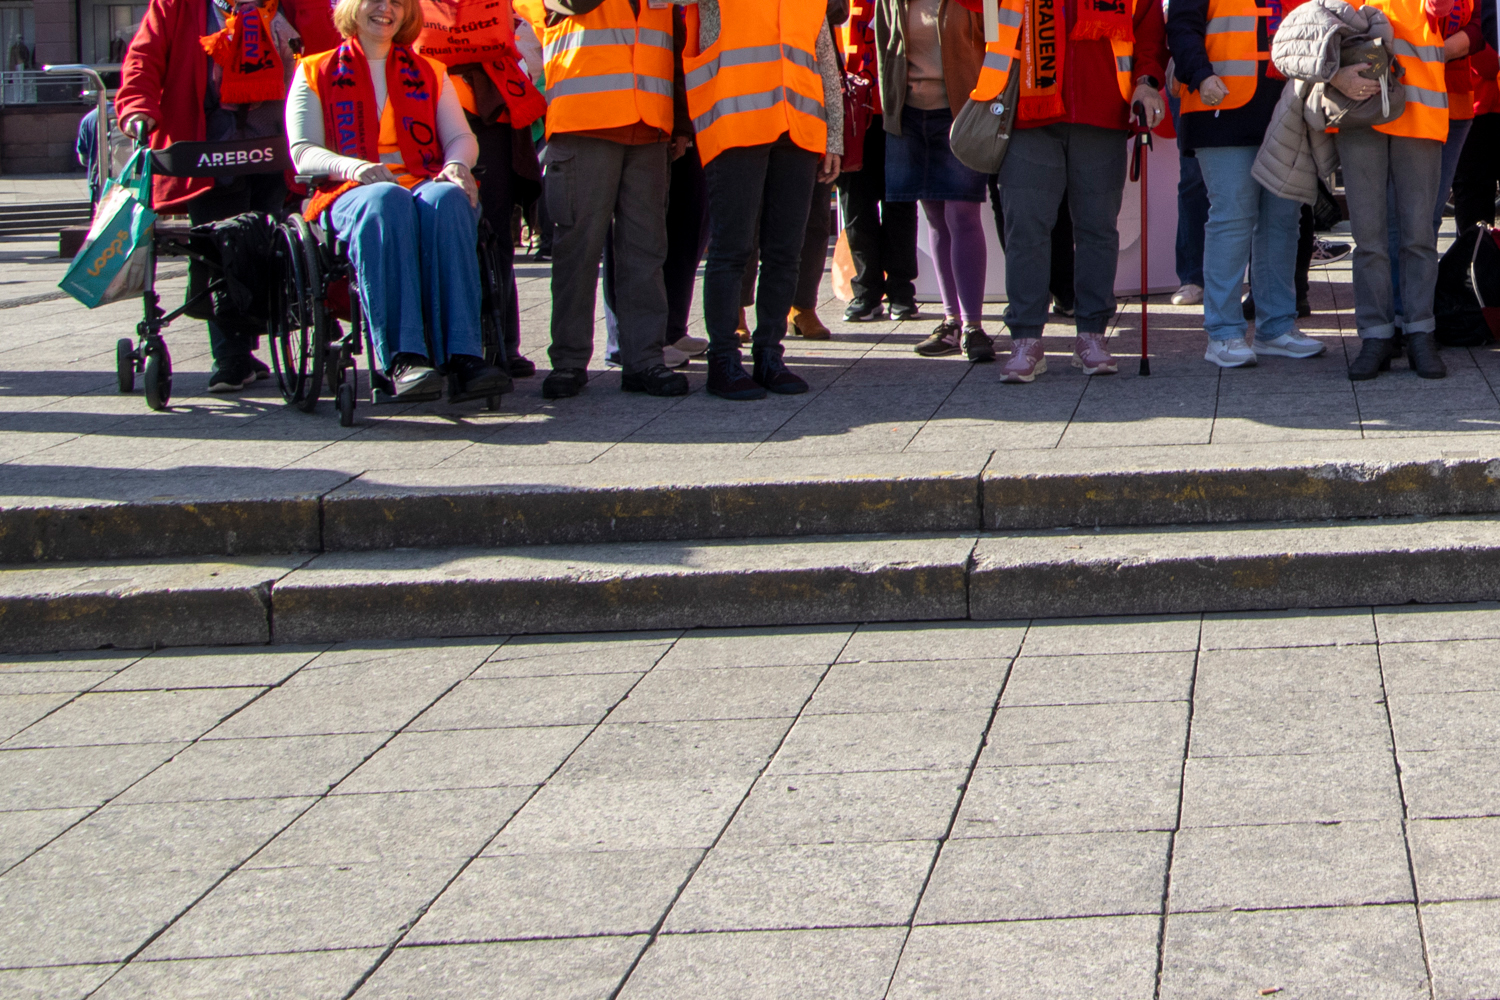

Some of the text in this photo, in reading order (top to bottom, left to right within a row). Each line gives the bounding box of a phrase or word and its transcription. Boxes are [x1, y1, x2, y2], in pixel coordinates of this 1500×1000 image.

[423, 17, 500, 34] unterstützt
[447, 36, 470, 44] den
[419, 45, 452, 56] Equal
[197, 147, 274, 167] AREBOS
